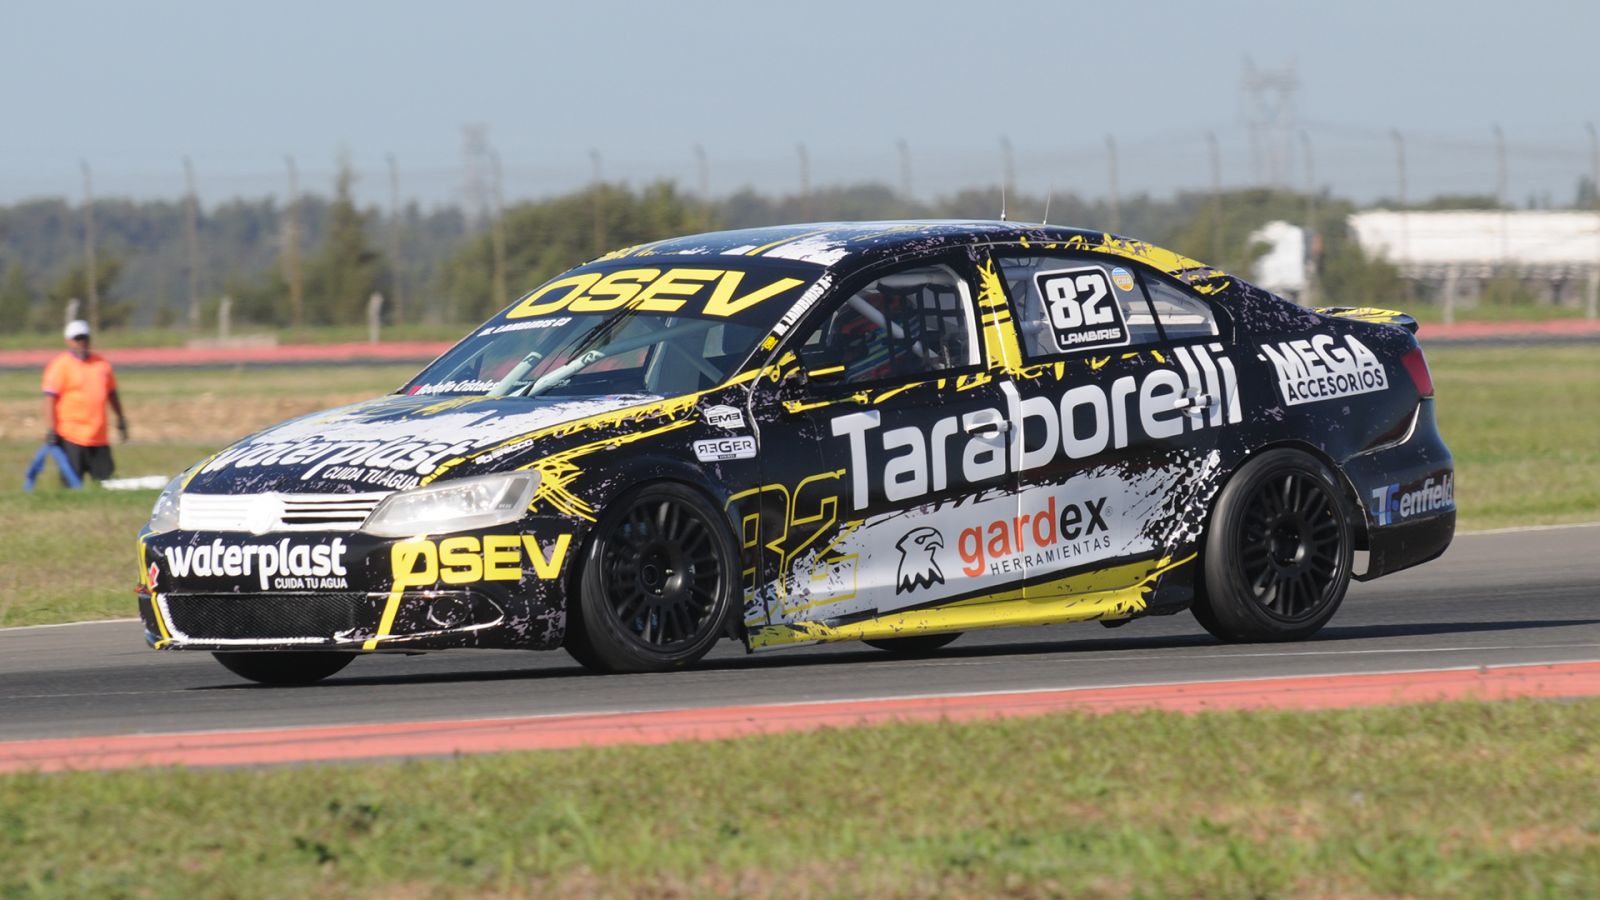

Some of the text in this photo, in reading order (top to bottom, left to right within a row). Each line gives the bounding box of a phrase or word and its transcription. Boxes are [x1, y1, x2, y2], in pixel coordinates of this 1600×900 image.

[506, 268, 804, 319] OSEV
[1045, 274, 1114, 329] 82
[1061, 328, 1121, 345] LAMBIRIS
[1260, 334, 1380, 381] MEGA
[1289, 368, 1384, 402] ACCESORIOS
[831, 342, 1242, 511] Taraborelli
[201, 435, 482, 481] waterplast
[322, 465, 419, 491] CUIDA TU AGUA
[958, 496, 1108, 578] gardex
[990, 535, 1111, 576] HERRAMIENTAS
[165, 538, 347, 590] waterplast
[275, 578, 348, 589] CUIDA TU AGUA
